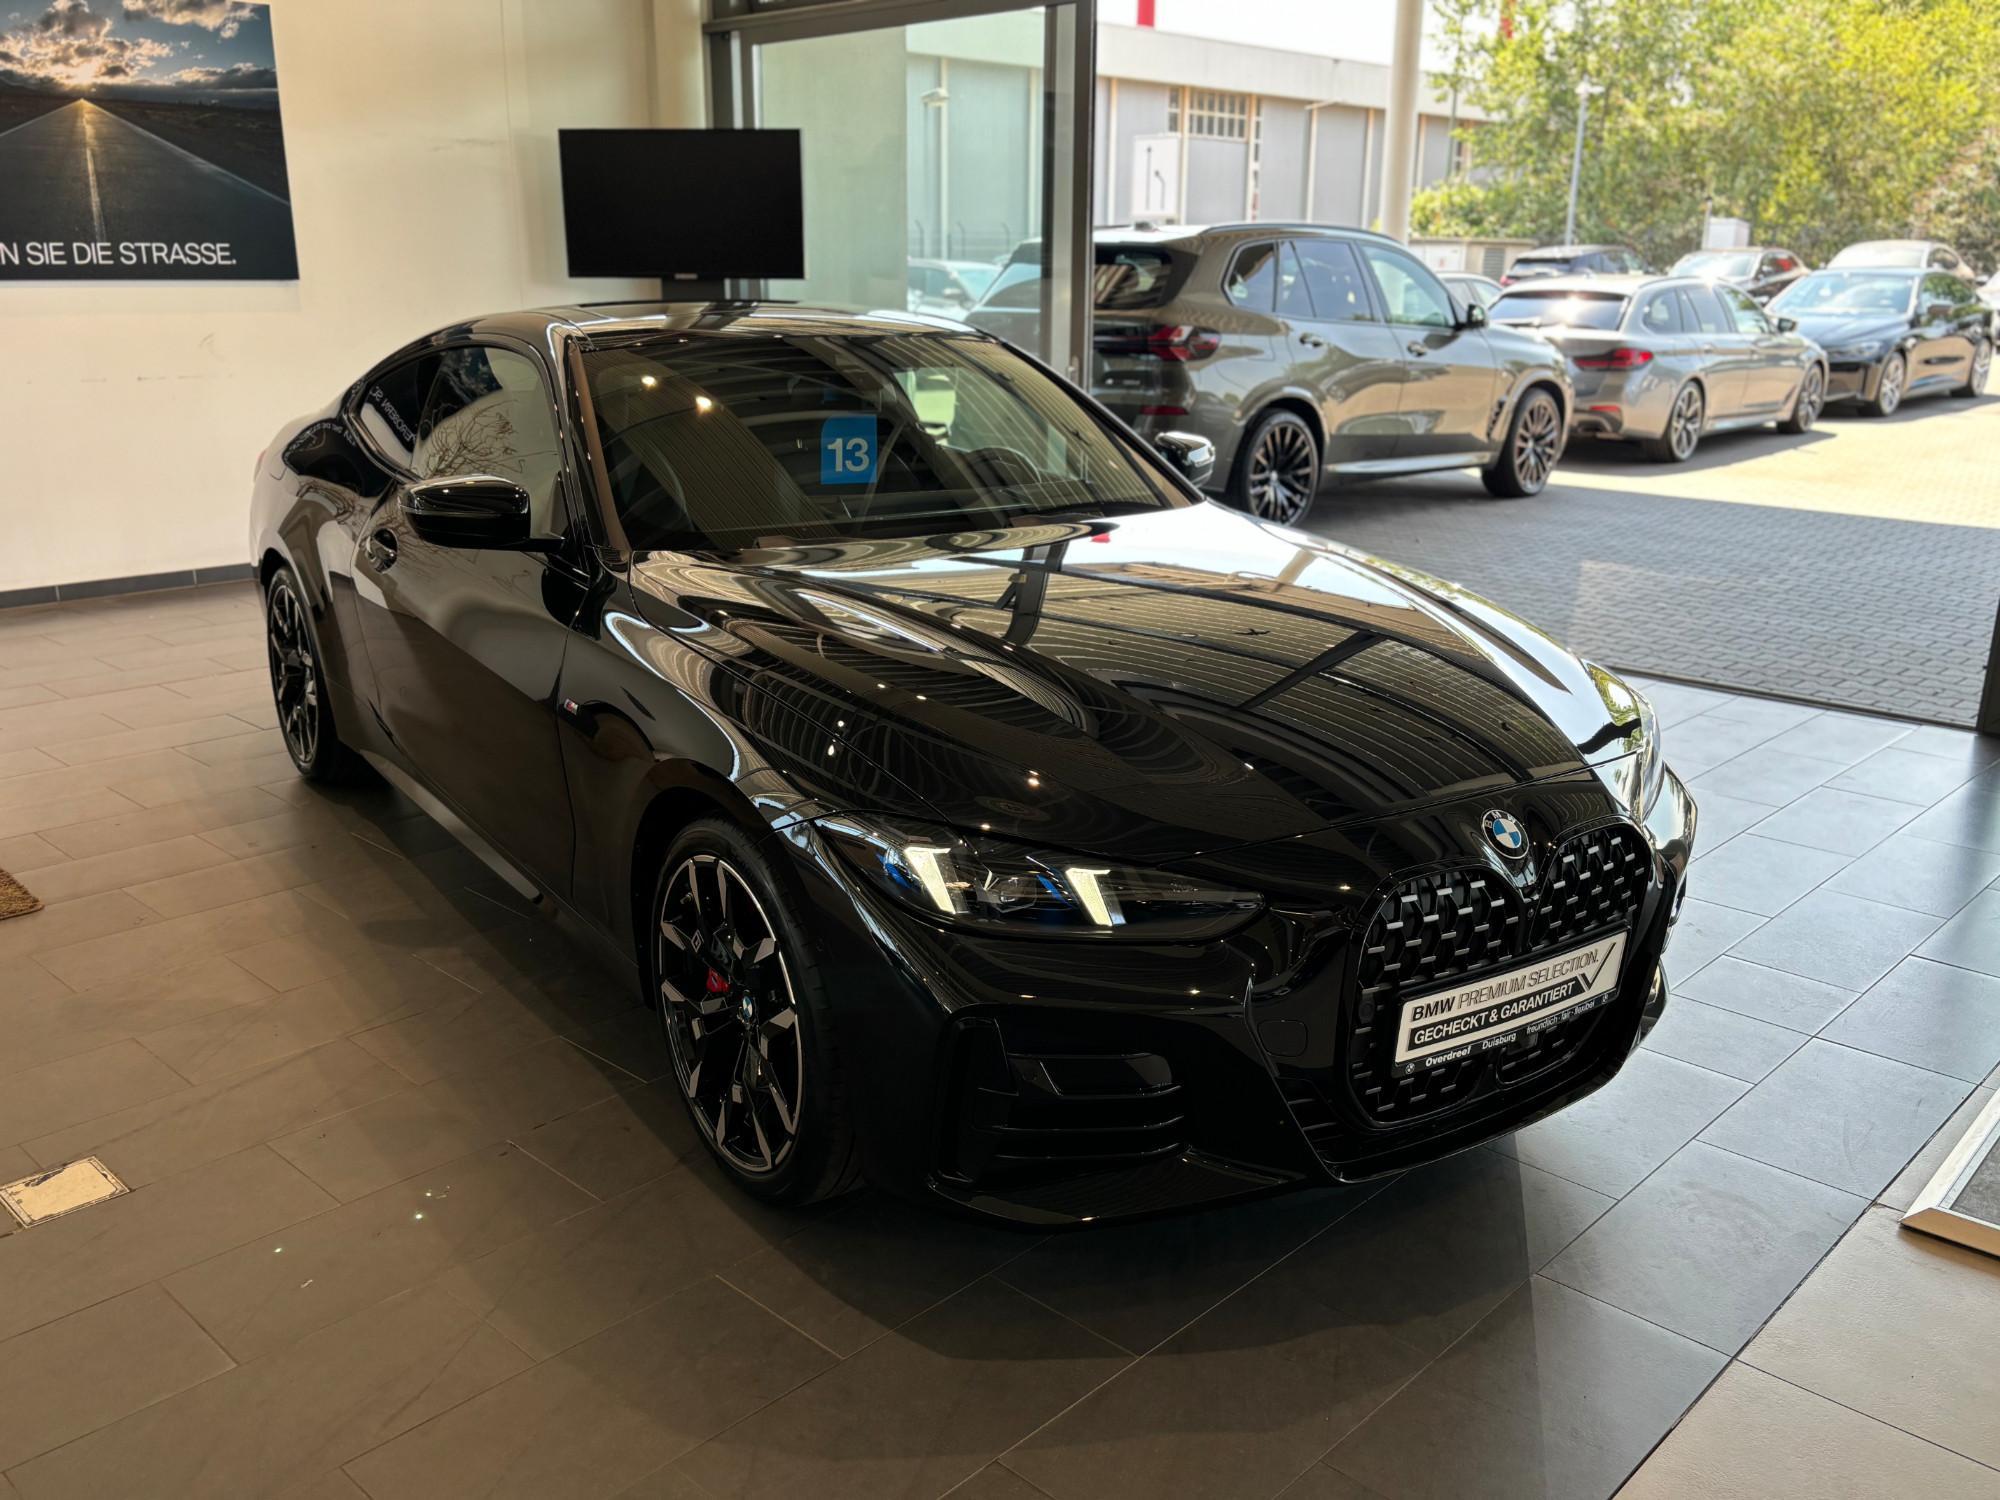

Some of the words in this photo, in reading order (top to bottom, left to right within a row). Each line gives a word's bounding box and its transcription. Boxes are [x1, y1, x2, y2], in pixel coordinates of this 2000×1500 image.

[26, 242, 67, 265] SIE
[72, 242, 114, 265] DIE
[119, 242, 237, 265] STRASSE.
[827, 437, 870, 472] 13
[1411, 996, 1455, 1021] BMW
[1458, 975, 1526, 1009] PREMIUM
[1528, 948, 1599, 987] SELECTION.
[1414, 1012, 1488, 1044] GECHECKT
[1489, 1008, 1498, 1022] &
[1501, 981, 1575, 1019] GARANTIERT
[1425, 1046, 1472, 1067] Overdreef
[1482, 1033, 1517, 1050] Duisburg
